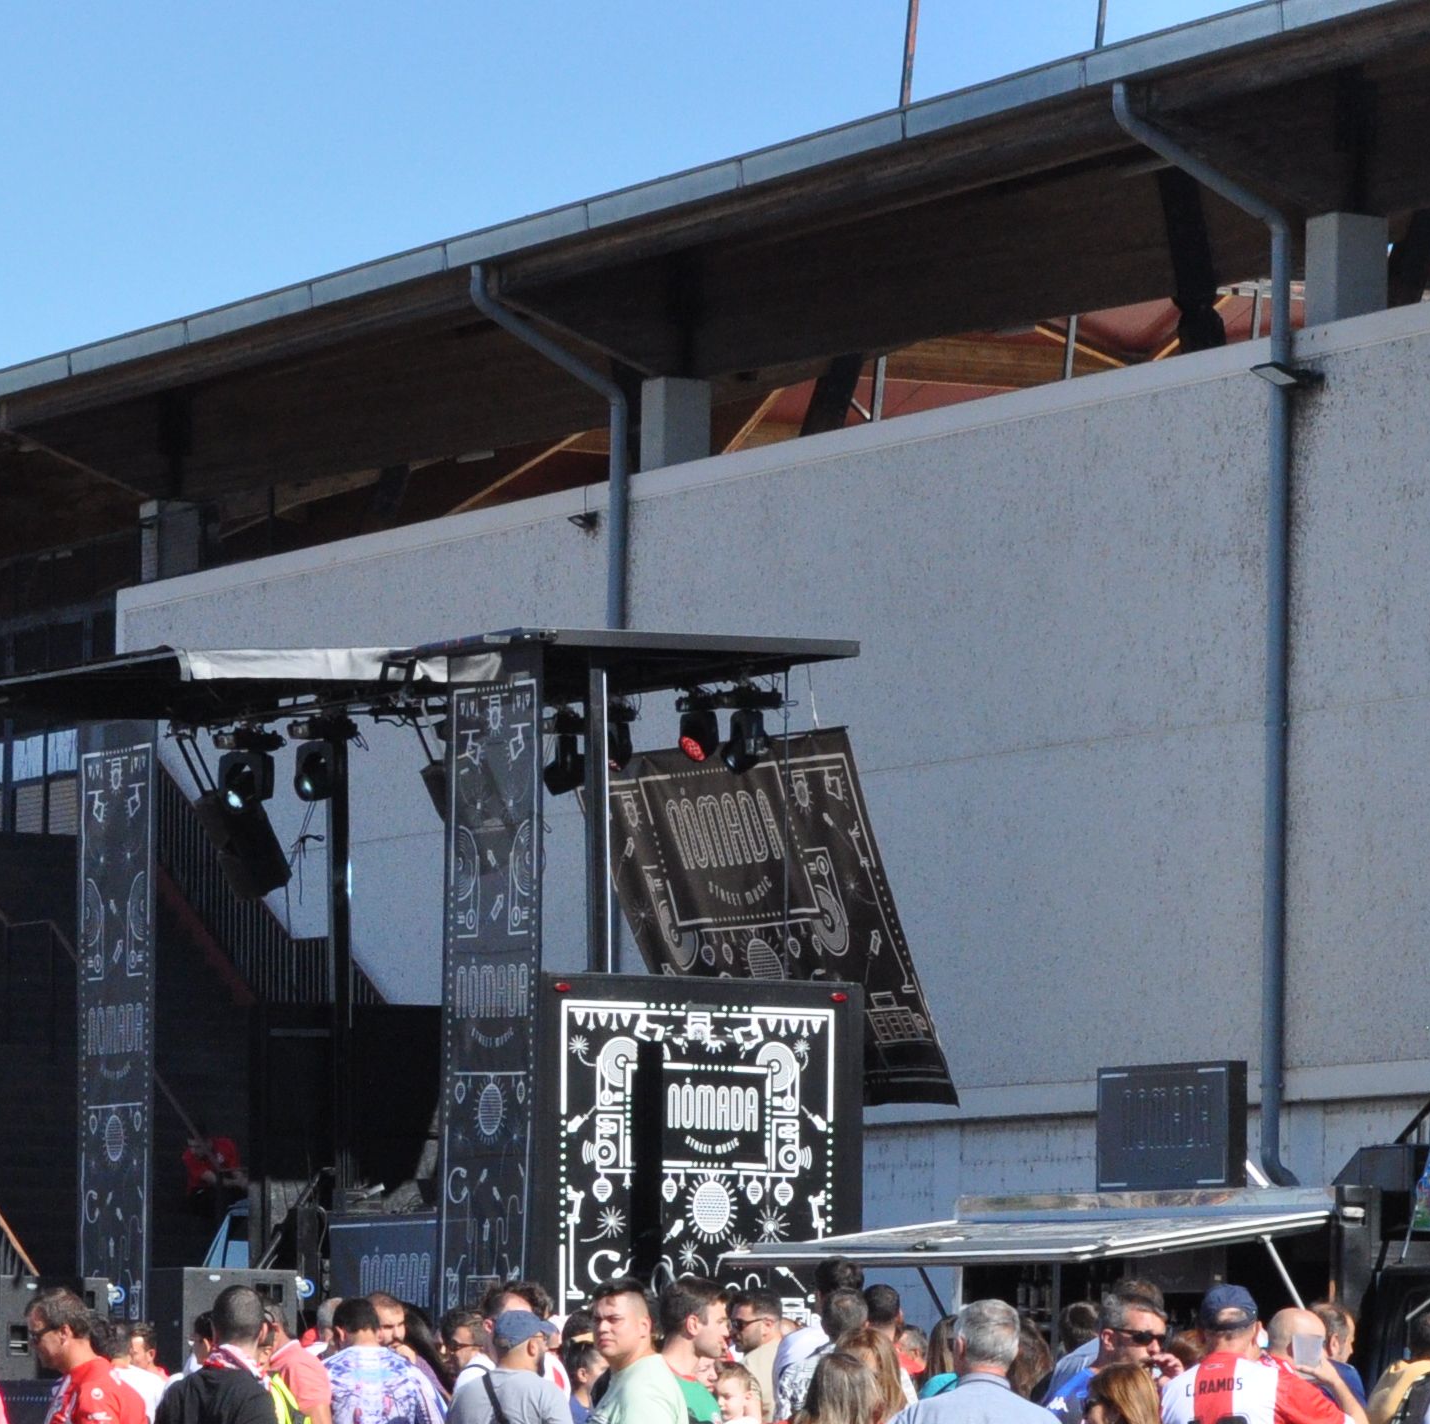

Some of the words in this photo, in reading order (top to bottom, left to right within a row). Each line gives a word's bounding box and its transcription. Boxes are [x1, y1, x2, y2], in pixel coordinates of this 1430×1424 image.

[665, 787, 786, 870] NÓMADA
[708, 880, 742, 906] STREET
[744, 875, 773, 905] MUSIC
[667, 1077, 759, 1132] NÓMADA
[1199, 1377, 1243, 1395] RAMOS
